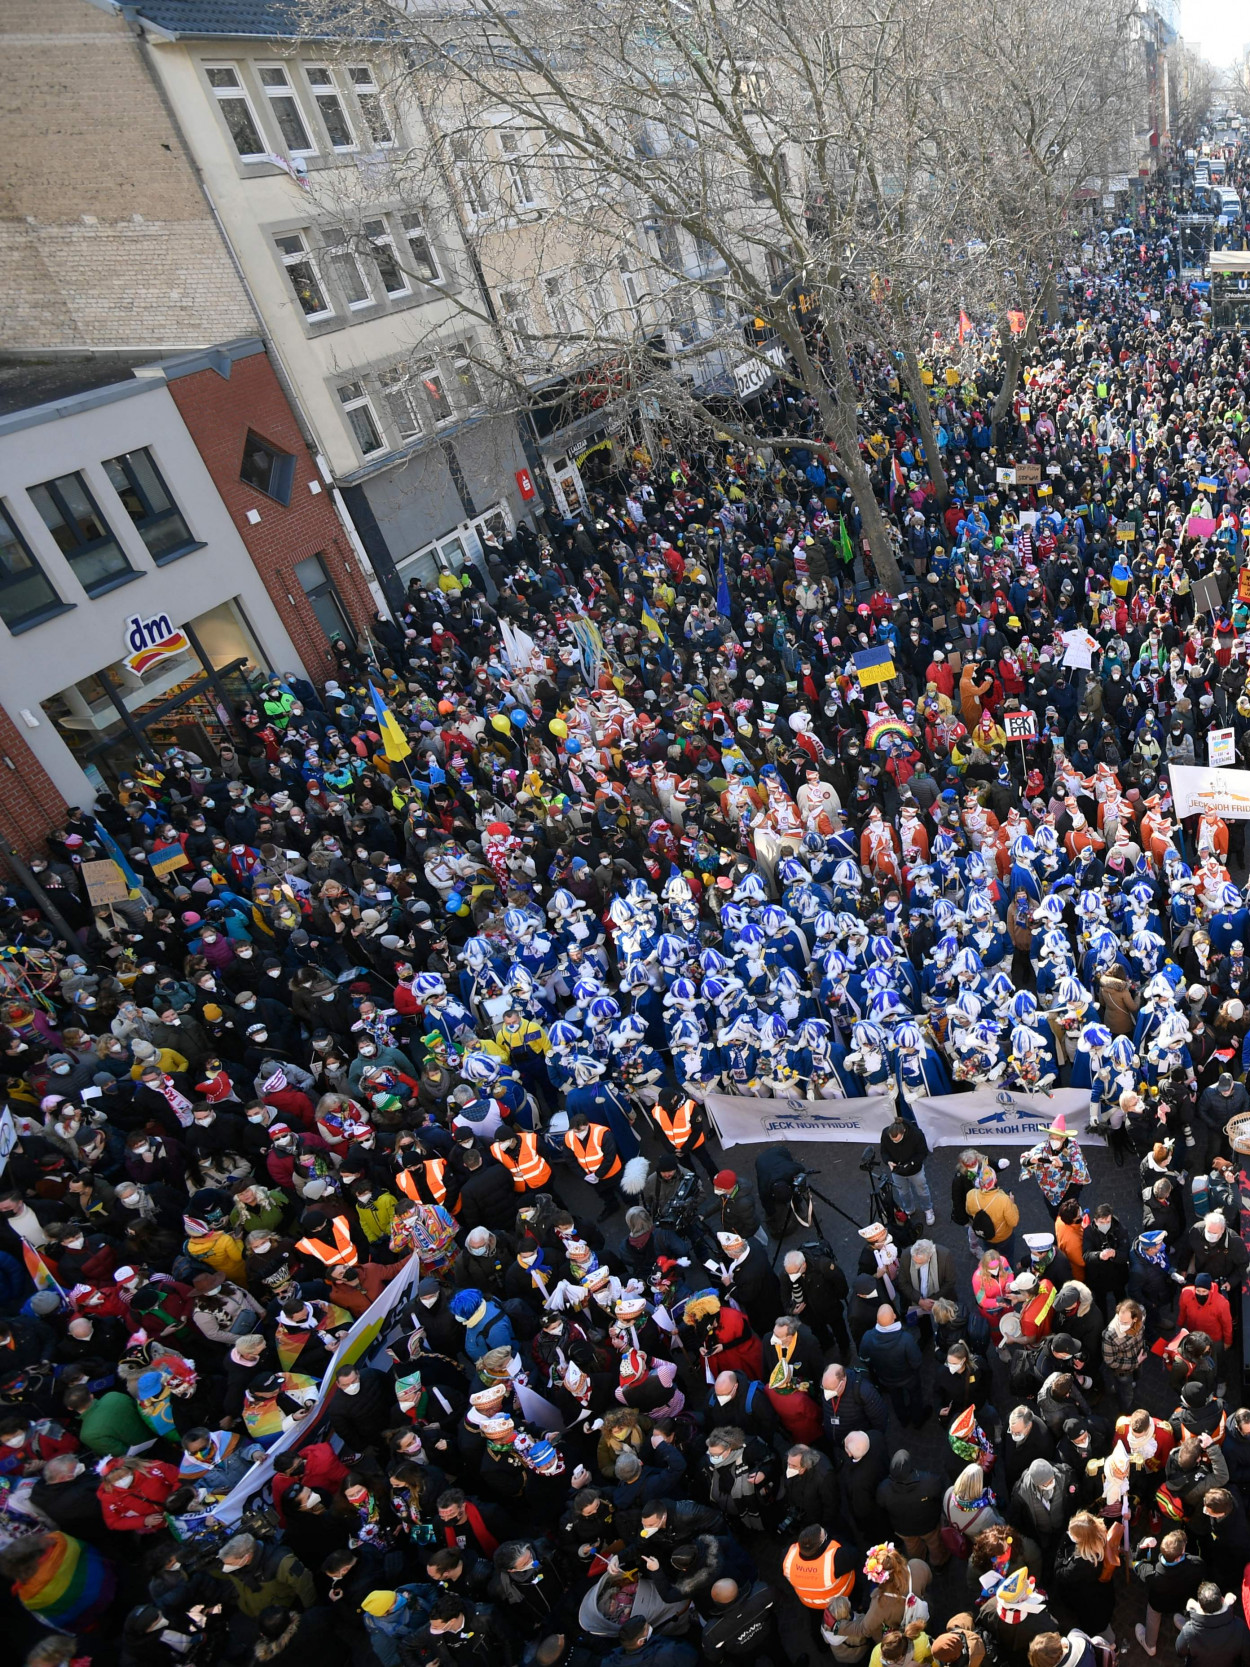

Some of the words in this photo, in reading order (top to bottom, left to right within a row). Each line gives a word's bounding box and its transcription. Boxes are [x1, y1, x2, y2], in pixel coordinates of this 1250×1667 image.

[130, 615, 173, 652] dm
[1009, 717, 1030, 727] FCK
[1010, 726, 1031, 736] PTN
[1188, 799, 1209, 810] JECK
[1210, 802, 1228, 811] NOH
[765, 1119, 793, 1132] JECK
[794, 1119, 818, 1131] NOH
[820, 1119, 861, 1130] FRIDDE
[966, 1127, 992, 1136] JECK
[995, 1125, 1018, 1136] NOH
[795, 1564, 818, 1573] WuVo
[737, 1622, 762, 1641] WuVo
